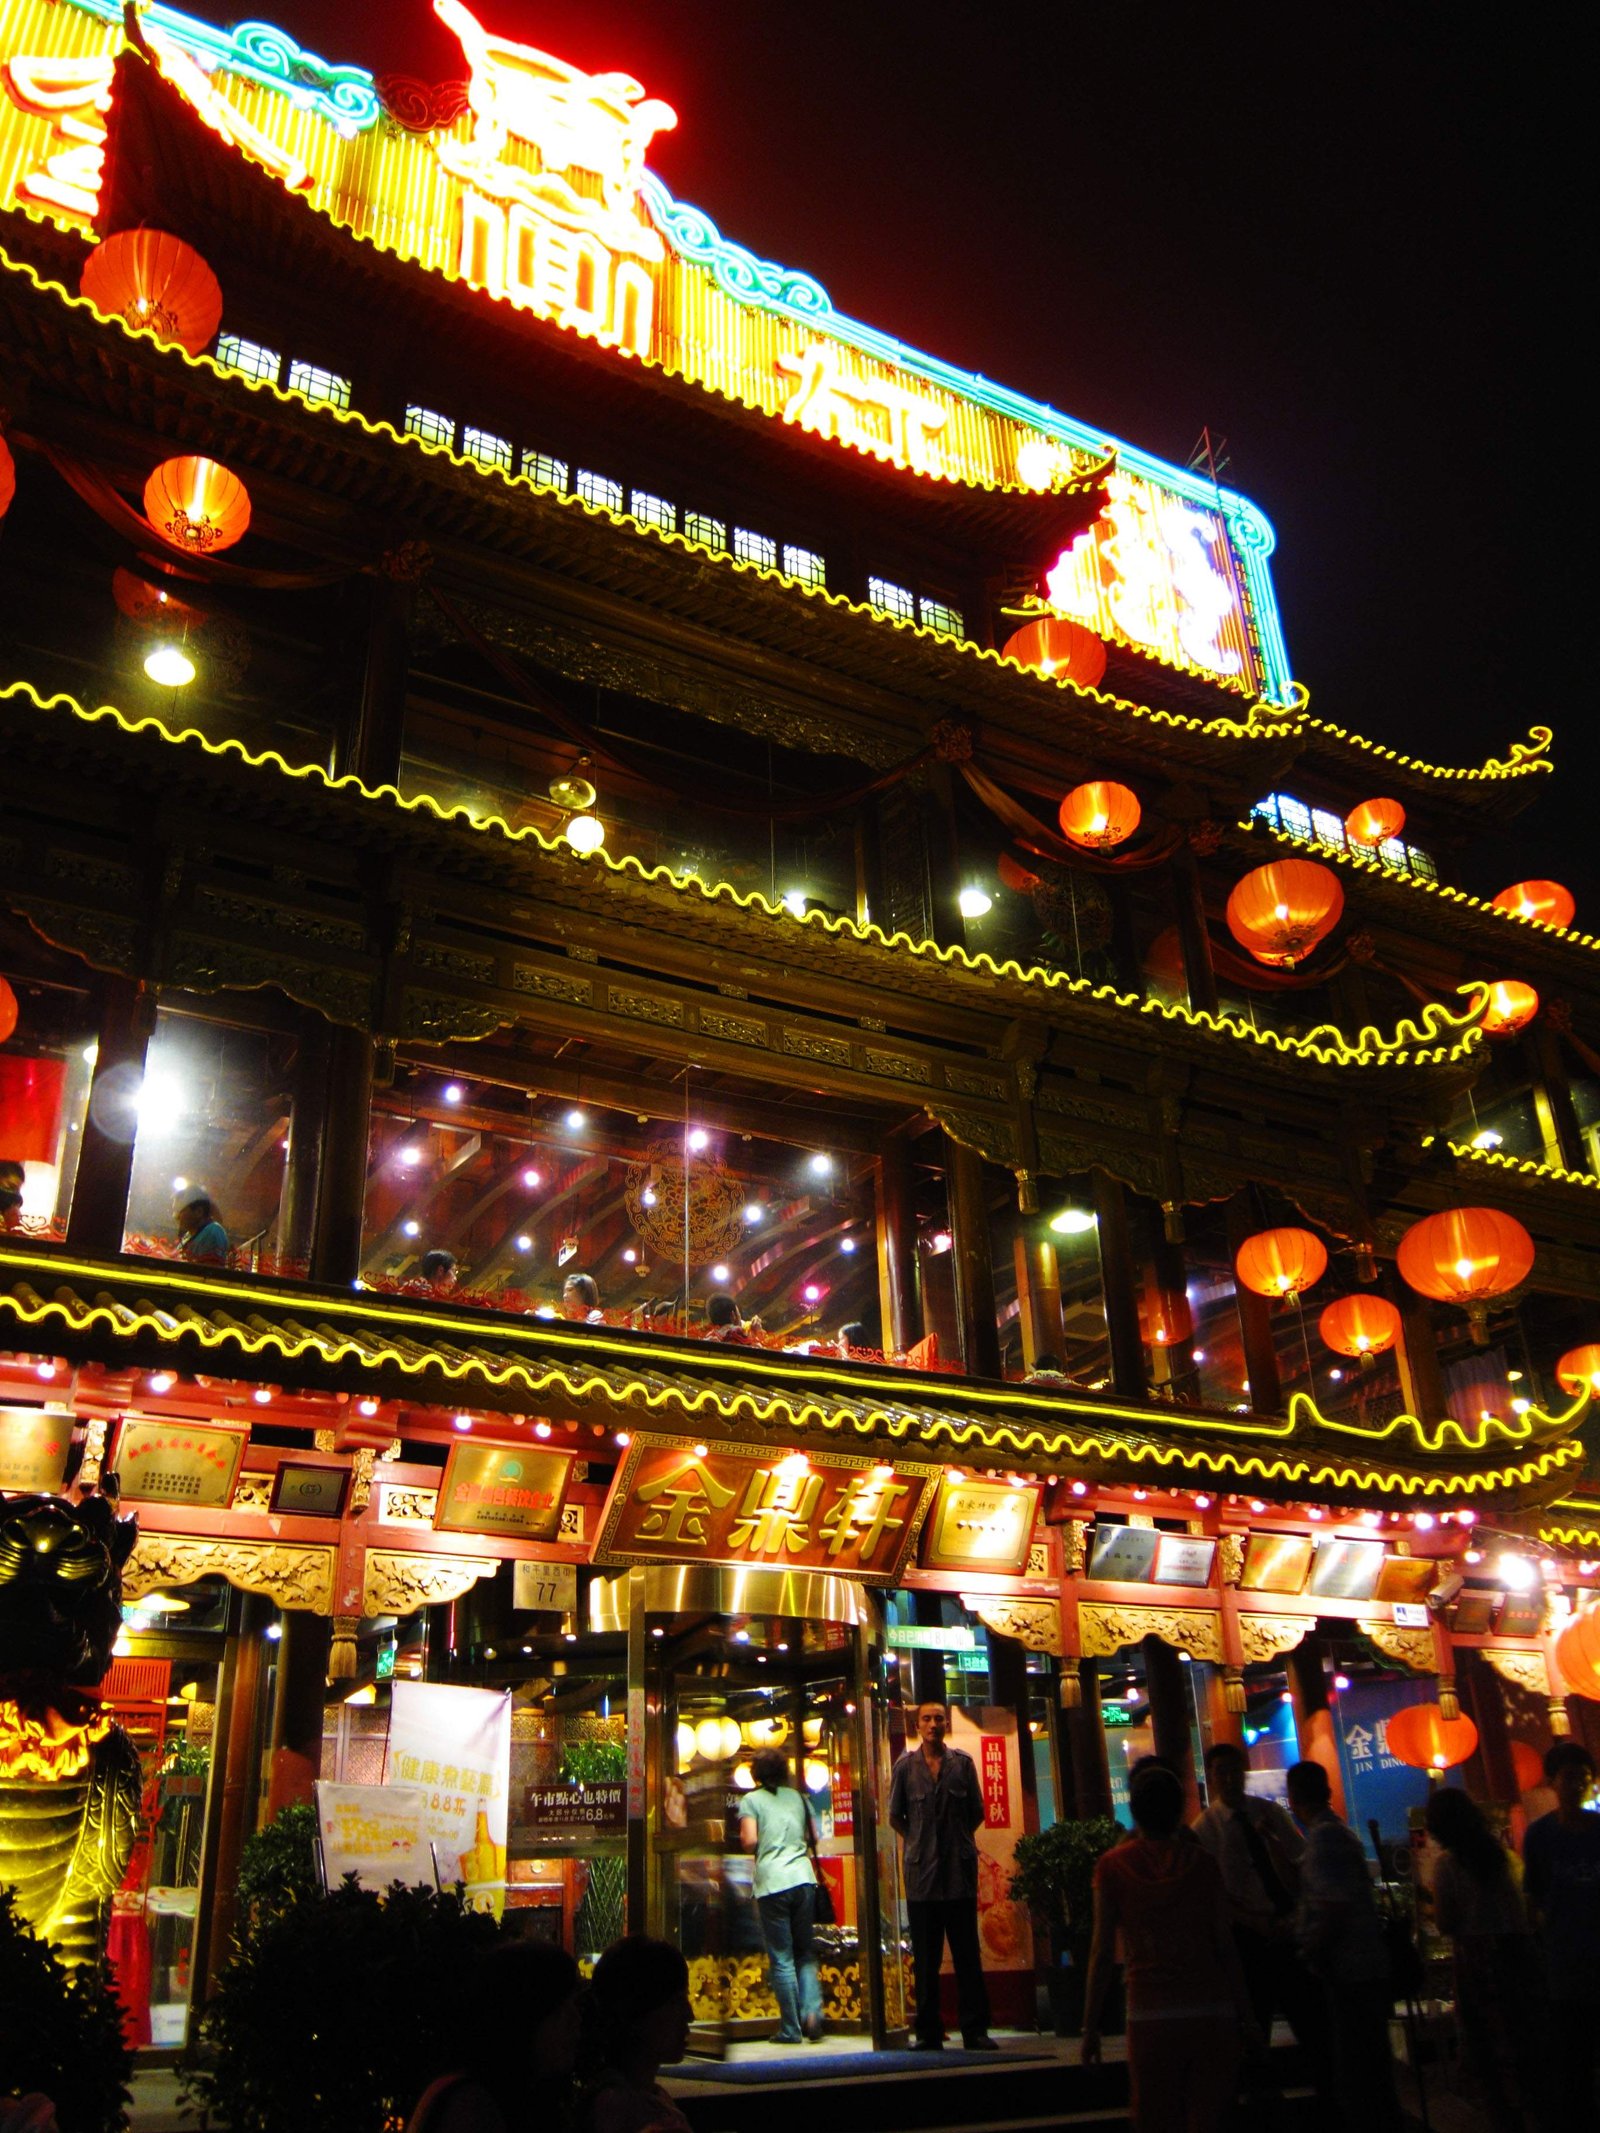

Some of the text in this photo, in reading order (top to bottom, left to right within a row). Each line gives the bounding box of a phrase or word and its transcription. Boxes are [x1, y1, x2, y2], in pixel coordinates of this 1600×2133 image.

[634, 1460, 910, 1561] 金鼎轩
[536, 1582, 557, 1602] 77
[1354, 1761, 1374, 1775] JIN
[985, 1742, 1006, 1823] 品味中秋
[530, 1788, 622, 1808] 午市點心也特價
